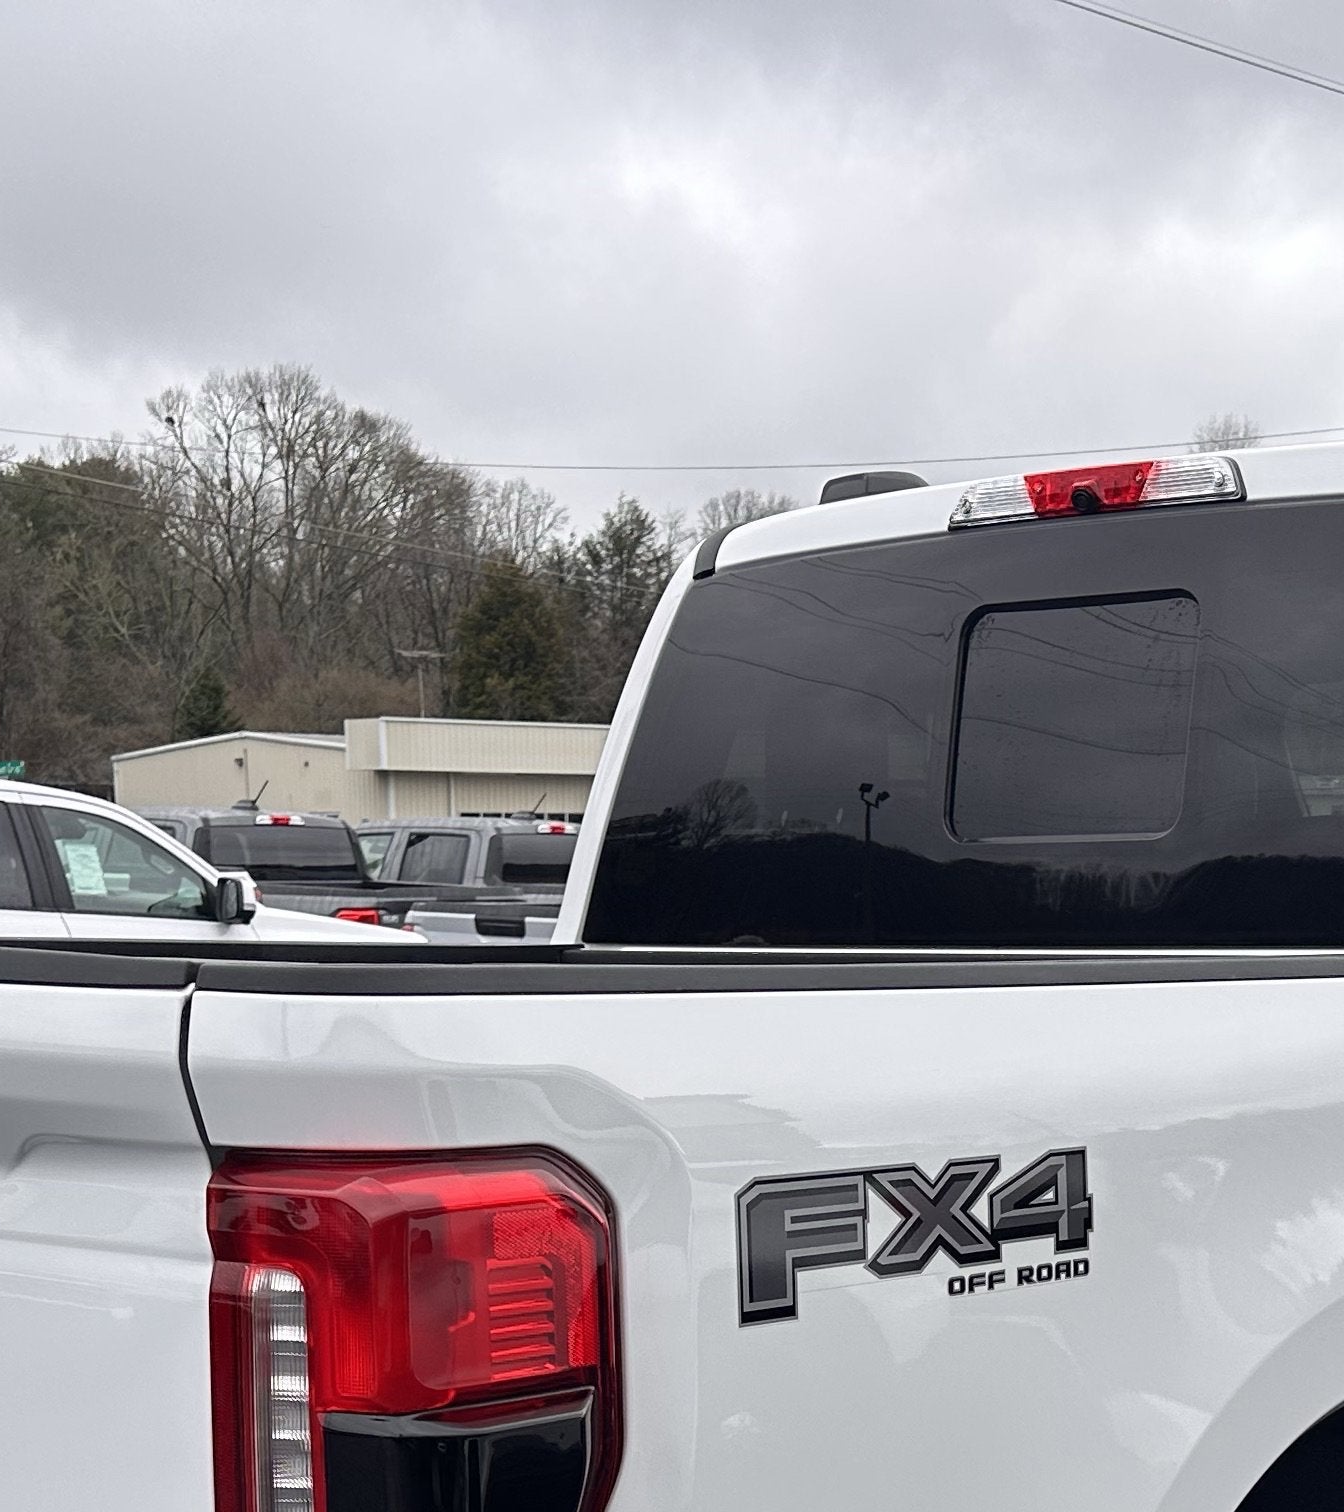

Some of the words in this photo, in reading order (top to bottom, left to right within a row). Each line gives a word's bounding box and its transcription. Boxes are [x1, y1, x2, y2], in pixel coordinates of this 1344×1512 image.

[733, 1146, 1094, 1328] FX4
[947, 1268, 1007, 1296] OFF
[1016, 1257, 1090, 1286] ROAD
